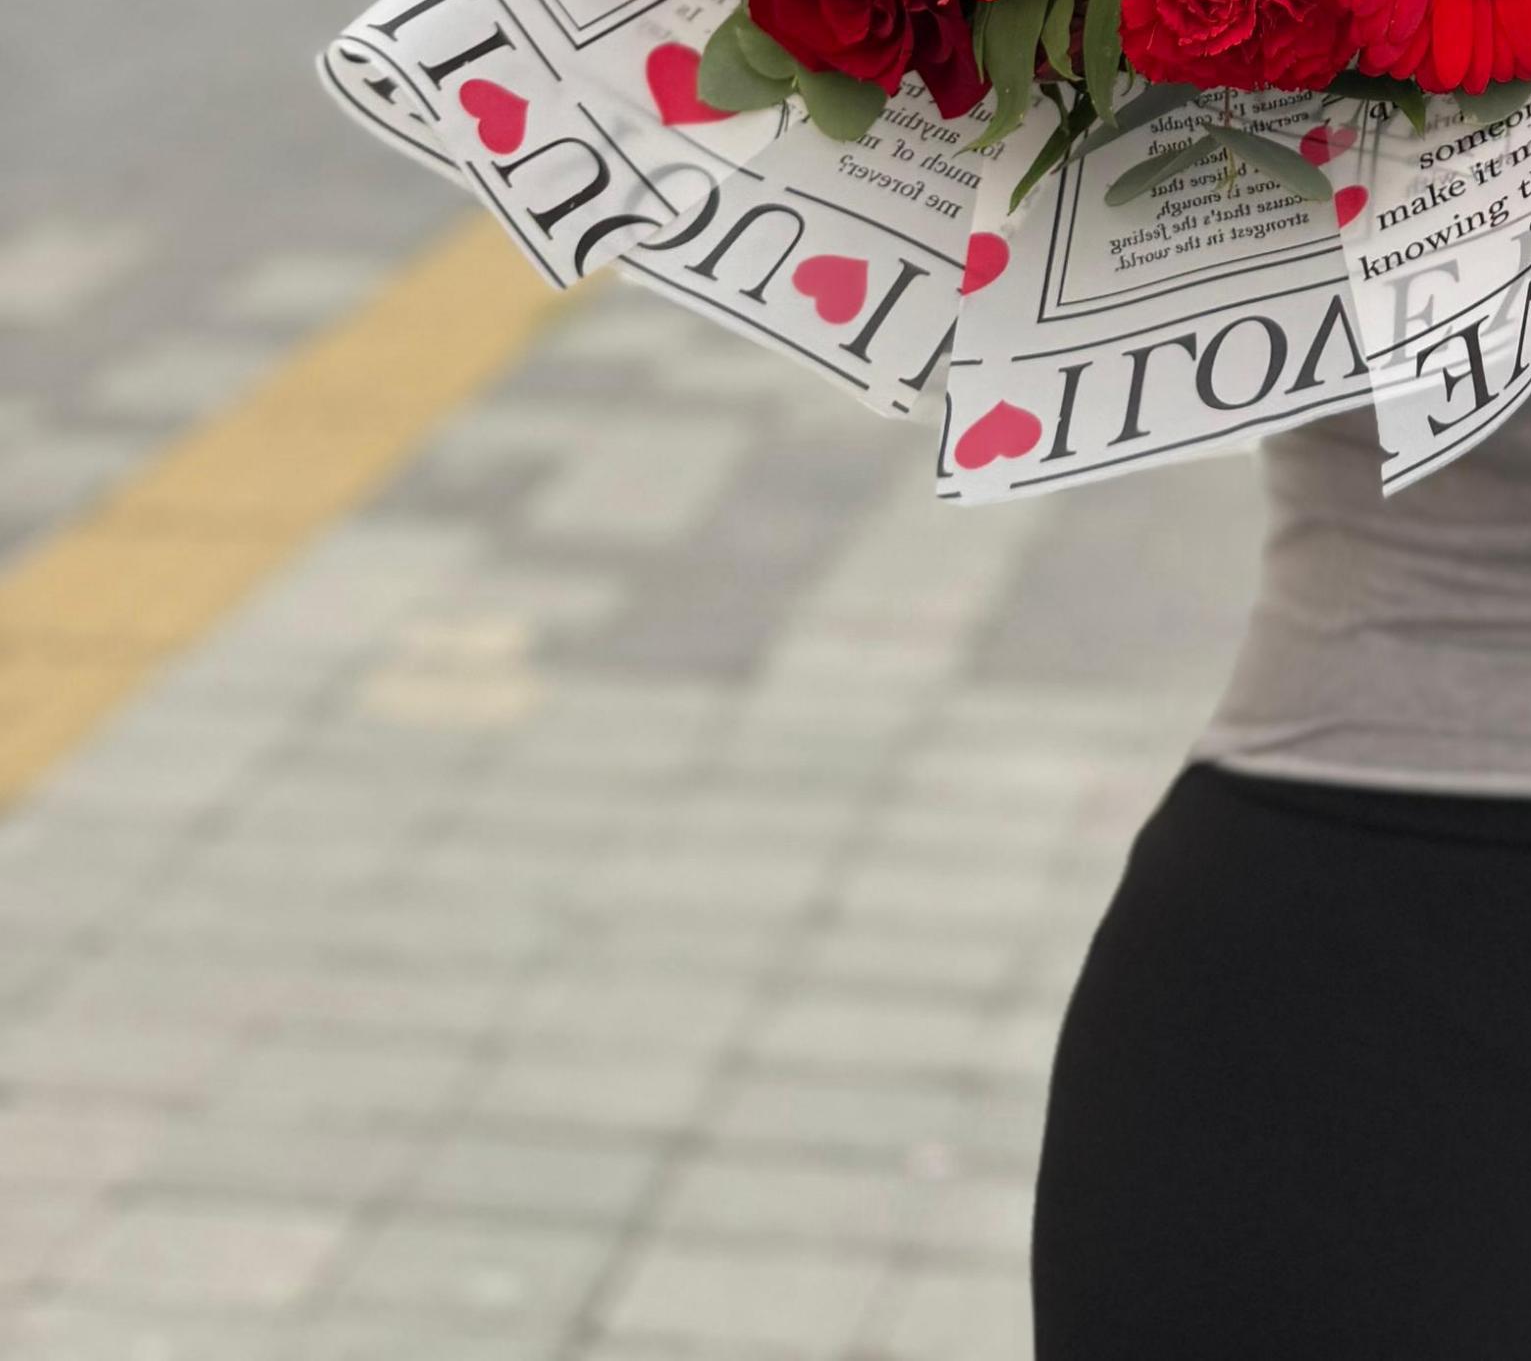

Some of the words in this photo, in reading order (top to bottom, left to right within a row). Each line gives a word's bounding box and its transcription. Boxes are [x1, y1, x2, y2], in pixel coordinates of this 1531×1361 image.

[1376, 180, 1467, 232] make
[1475, 159, 1503, 187] it
[1358, 196, 1511, 282] knowing
